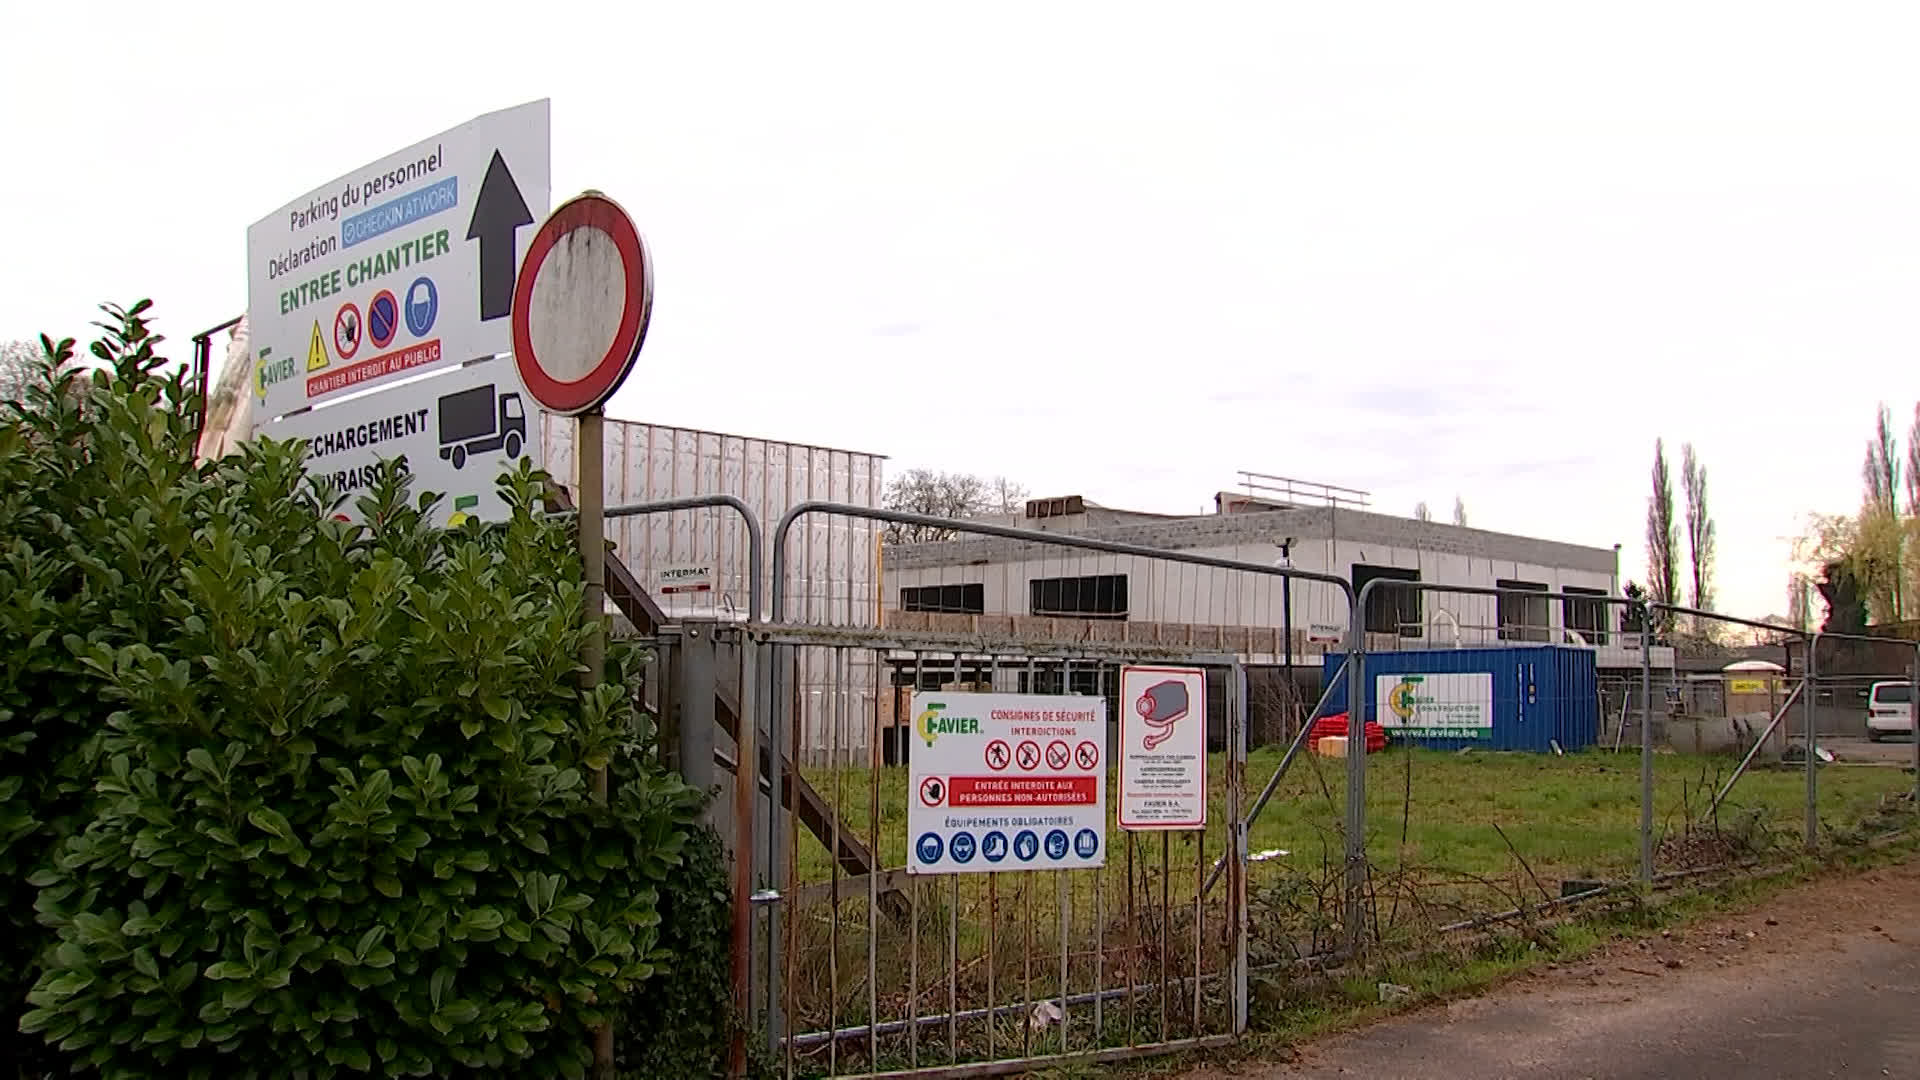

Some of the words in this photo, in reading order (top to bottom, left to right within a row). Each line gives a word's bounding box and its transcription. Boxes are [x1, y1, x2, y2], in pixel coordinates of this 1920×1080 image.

[290, 196, 339, 232] Parking
[341, 184, 361, 208] du
[363, 143, 443, 206] personnel
[269, 234, 337, 280] Déclaration
[280, 269, 342, 316] ENTREE
[346, 229, 450, 288] CHANTIER
[308, 373, 347, 395] CHANTIER
[347, 361, 387, 384] INTERDIT
[389, 356, 402, 371] AU
[404, 345, 439, 367] PUBLIC
[990, 710, 1041, 722] CONSIGNES
[1042, 710, 1054, 722] DE
[1055, 709, 1096, 722] SÉCURITÉ
[1011, 727, 1077, 736] INTERDICTIONS
[1391, 728, 1479, 738] www.favier.be
[975, 779, 1009, 791] ENTRÉE
[1011, 780, 1056, 791] INTERDITE
[1057, 781, 1073, 790] AUX
[959, 793, 1013, 803] PERSONNES
[944, 816, 1010, 828] ÉQUIPEMENTS
[1011, 816, 1074, 827] OBLIGATOIRES
